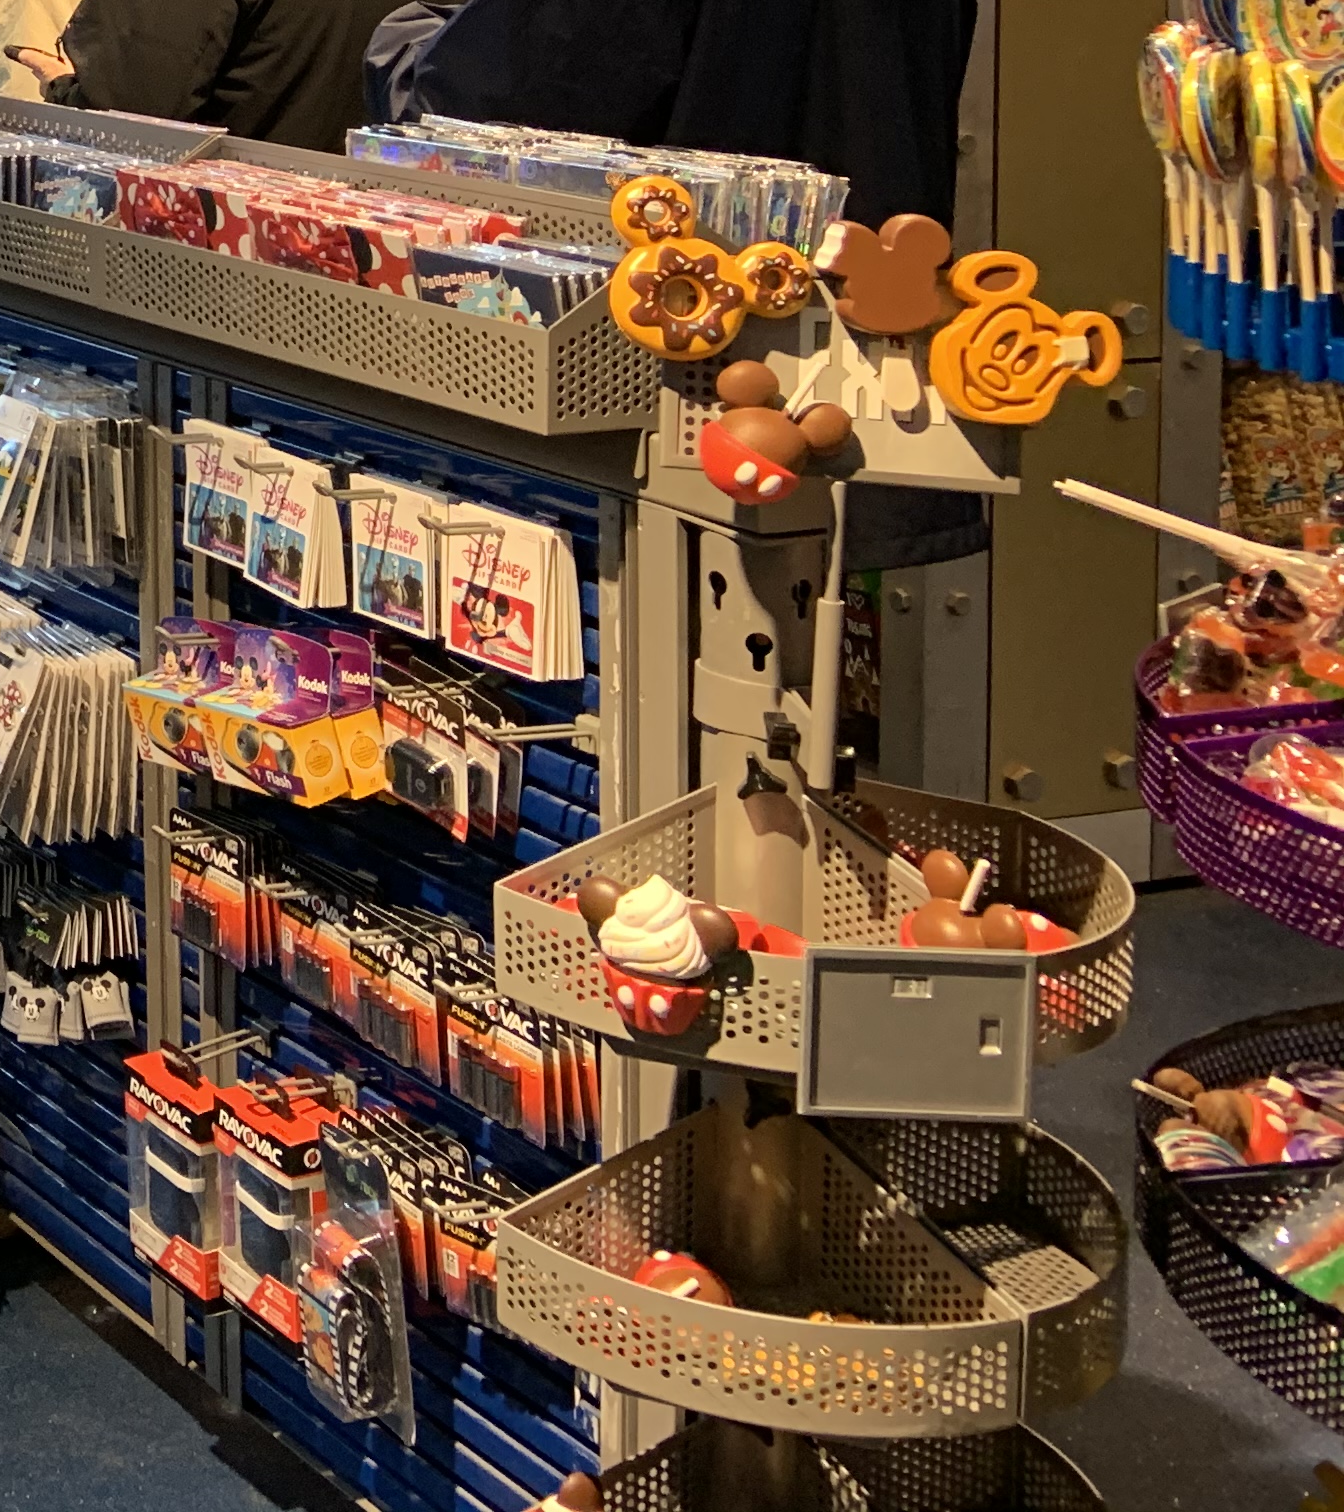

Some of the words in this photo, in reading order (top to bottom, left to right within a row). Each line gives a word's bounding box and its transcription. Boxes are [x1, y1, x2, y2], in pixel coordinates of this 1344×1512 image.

[192, 445, 245, 494] Disney
[261, 473, 307, 527] Disney
[358, 502, 419, 555] Disney
[462, 533, 531, 591] Disney
[494, 576, 516, 589] CARD
[298, 675, 328, 694] Kodak
[341, 670, 371, 686] Kodak
[129, 696, 153, 759] Kodak
[200, 712, 227, 780] Kodak
[265, 770, 293, 790] Flash
[129, 1077, 192, 1135] RAYOVAC
[218, 1109, 283, 1169] RAYOVAC
[173, 1241, 184, 1259] 2
[169, 1259, 179, 1276] 2
[264, 1280, 274, 1298] 2
[258, 1299, 269, 1318] 2
